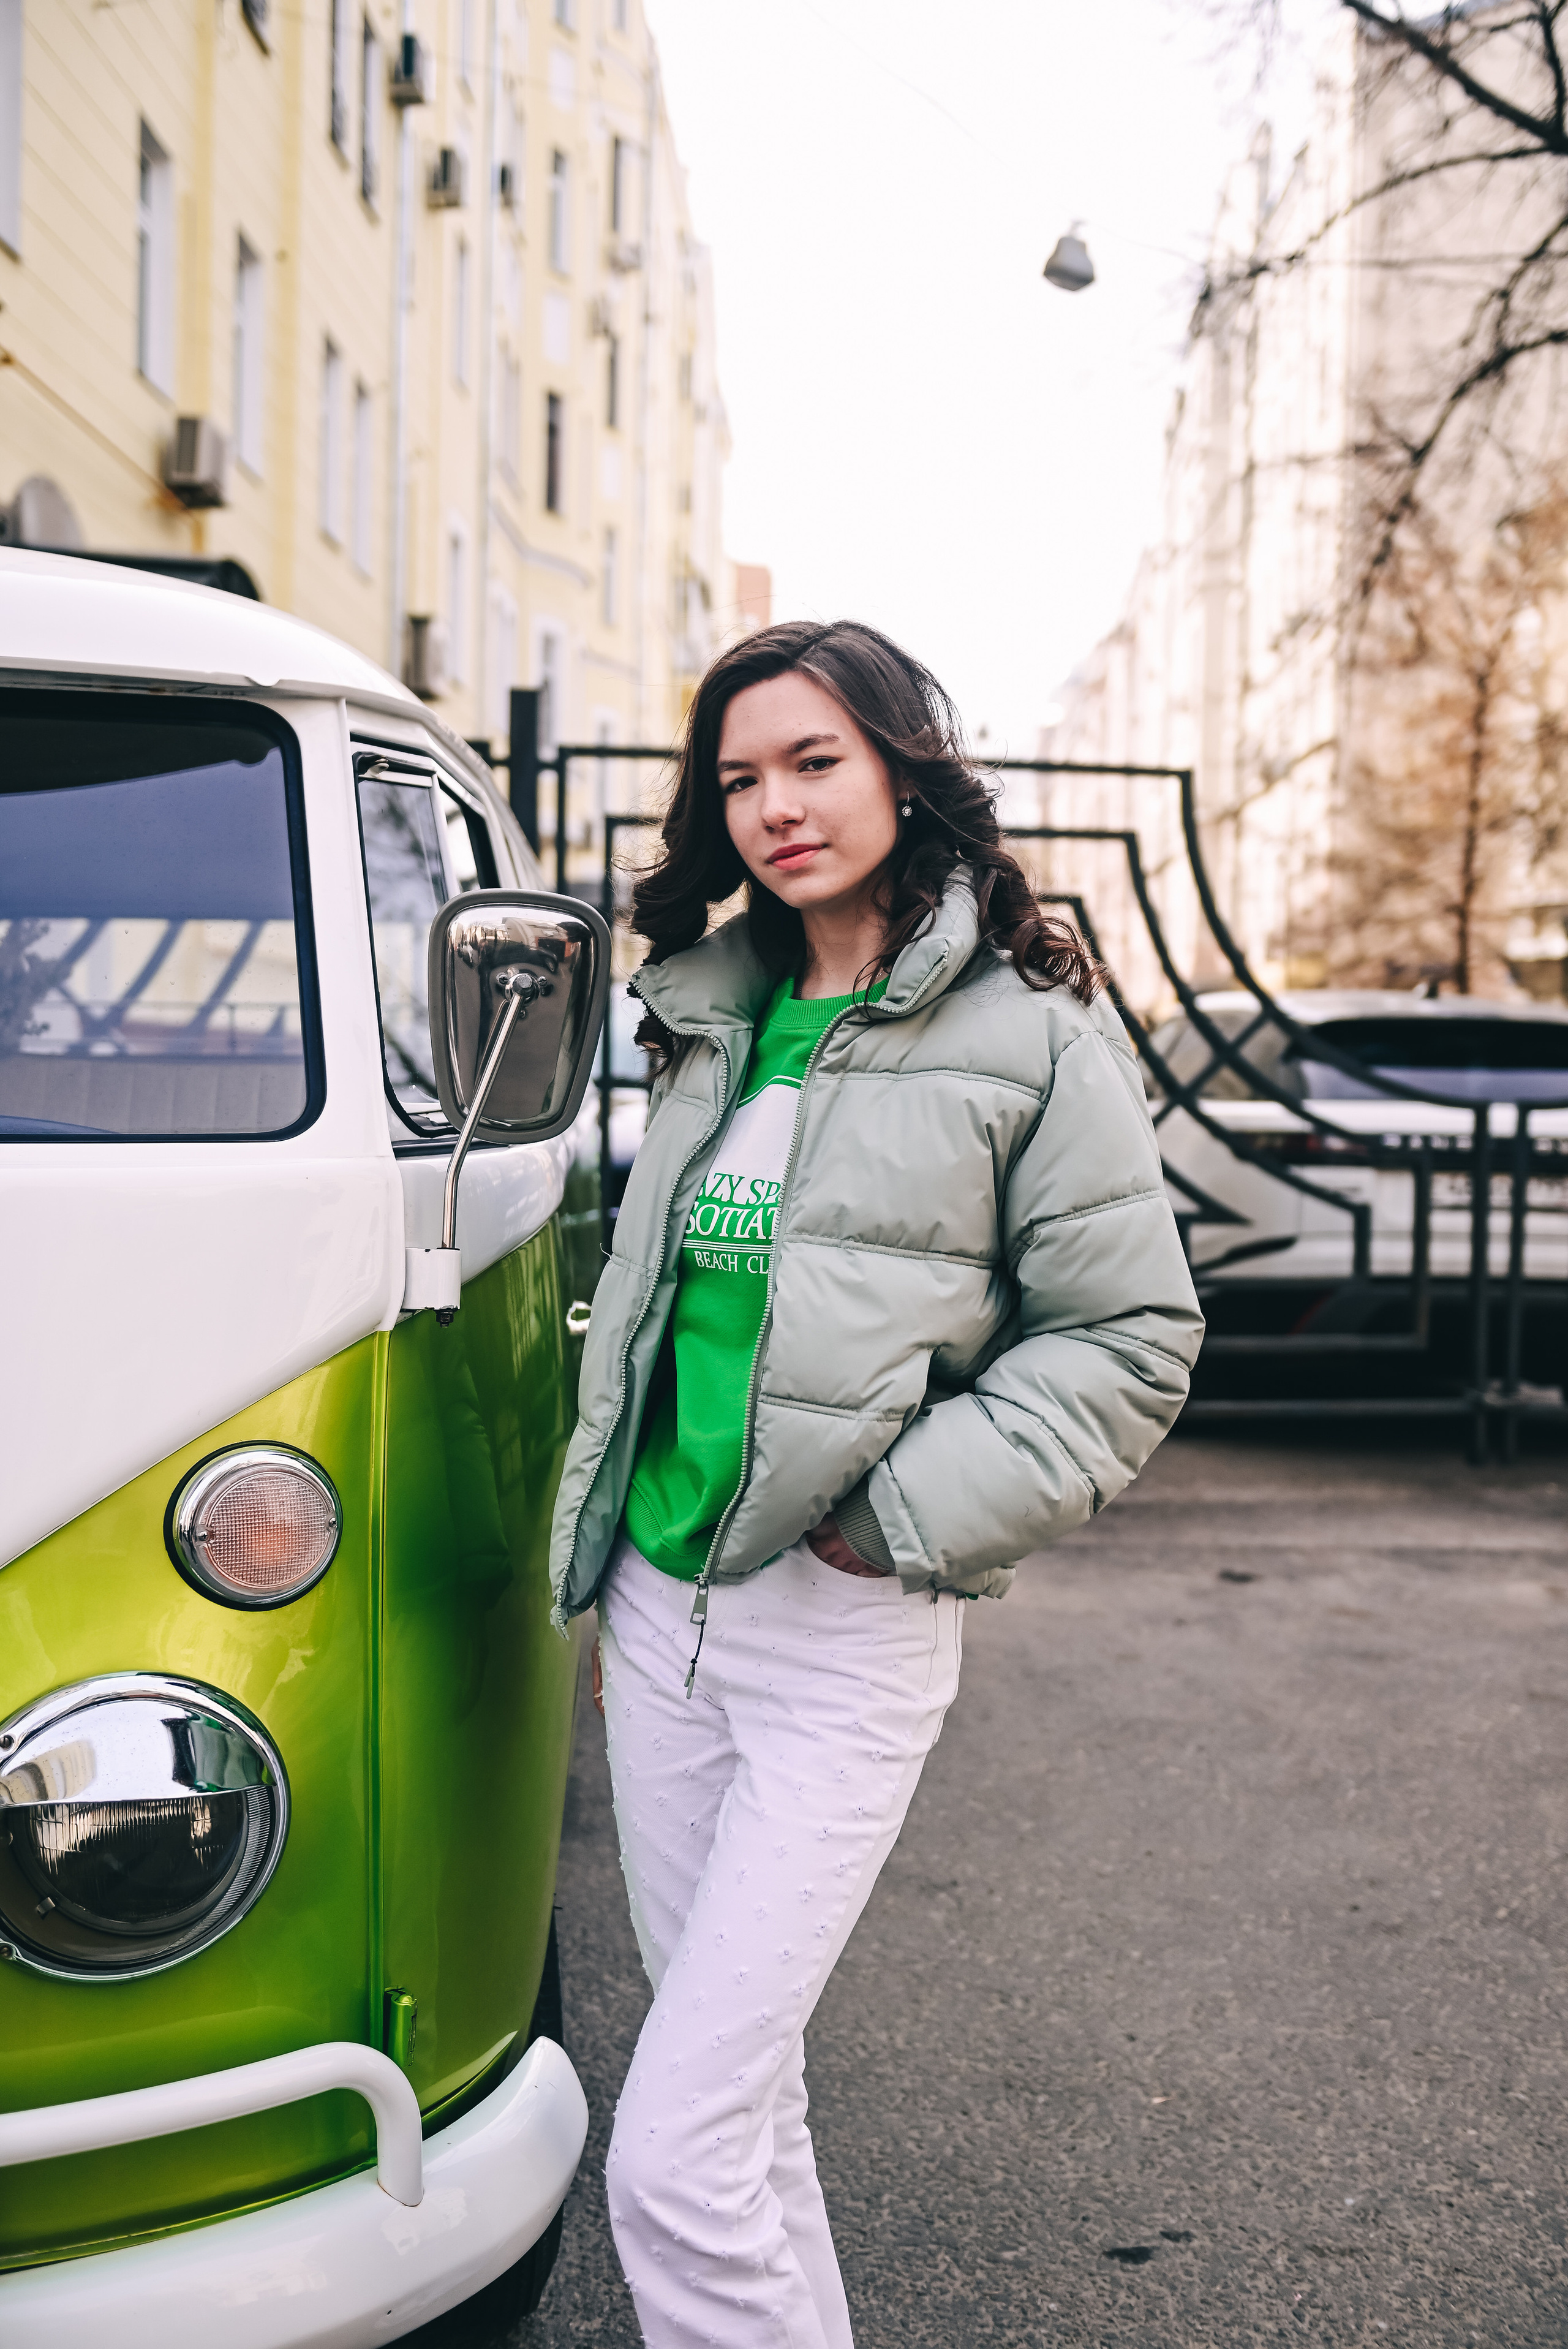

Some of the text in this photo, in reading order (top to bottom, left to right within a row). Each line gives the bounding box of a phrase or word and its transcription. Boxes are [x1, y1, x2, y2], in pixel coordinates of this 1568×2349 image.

[747, 1179, 782, 1206] SP
[694, 1250, 771, 1274] BEACH CL
